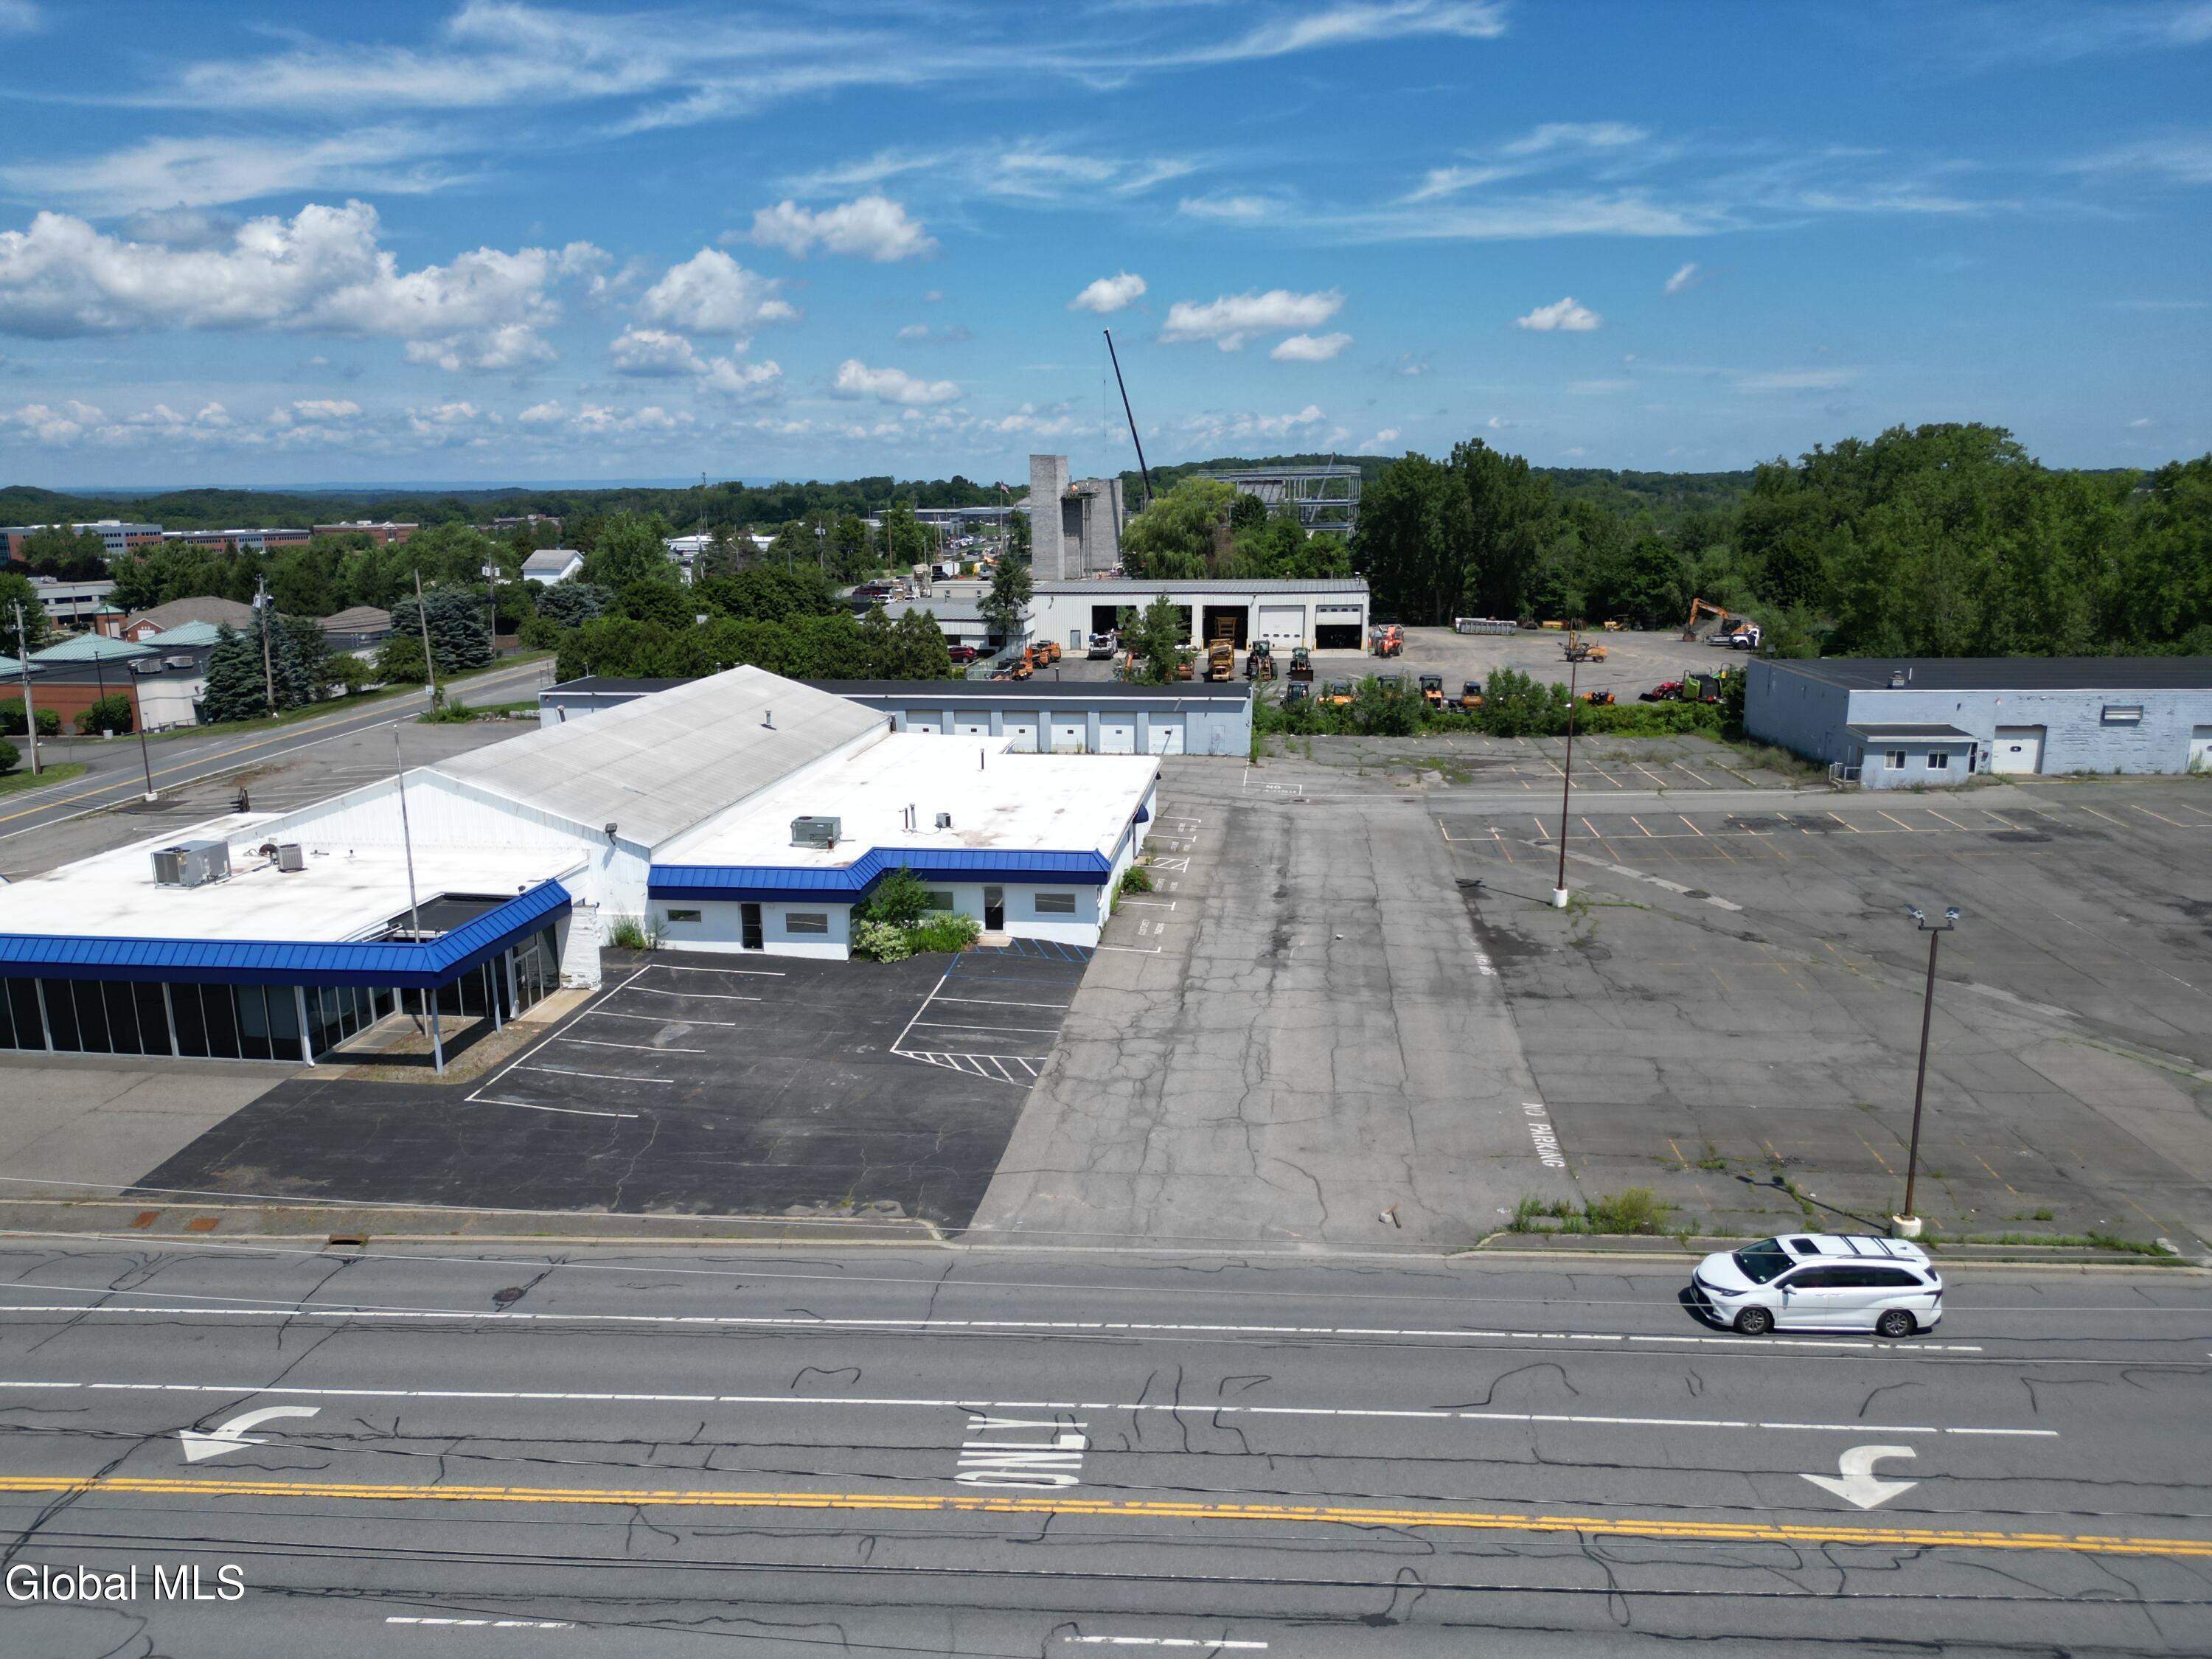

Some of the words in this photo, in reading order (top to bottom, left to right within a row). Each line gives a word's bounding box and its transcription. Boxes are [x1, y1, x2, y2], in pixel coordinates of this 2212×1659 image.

[1521, 1102, 1546, 1116] NO
[1528, 1123, 1565, 1167] PARKING
[954, 1416, 1088, 1489] ONLY
